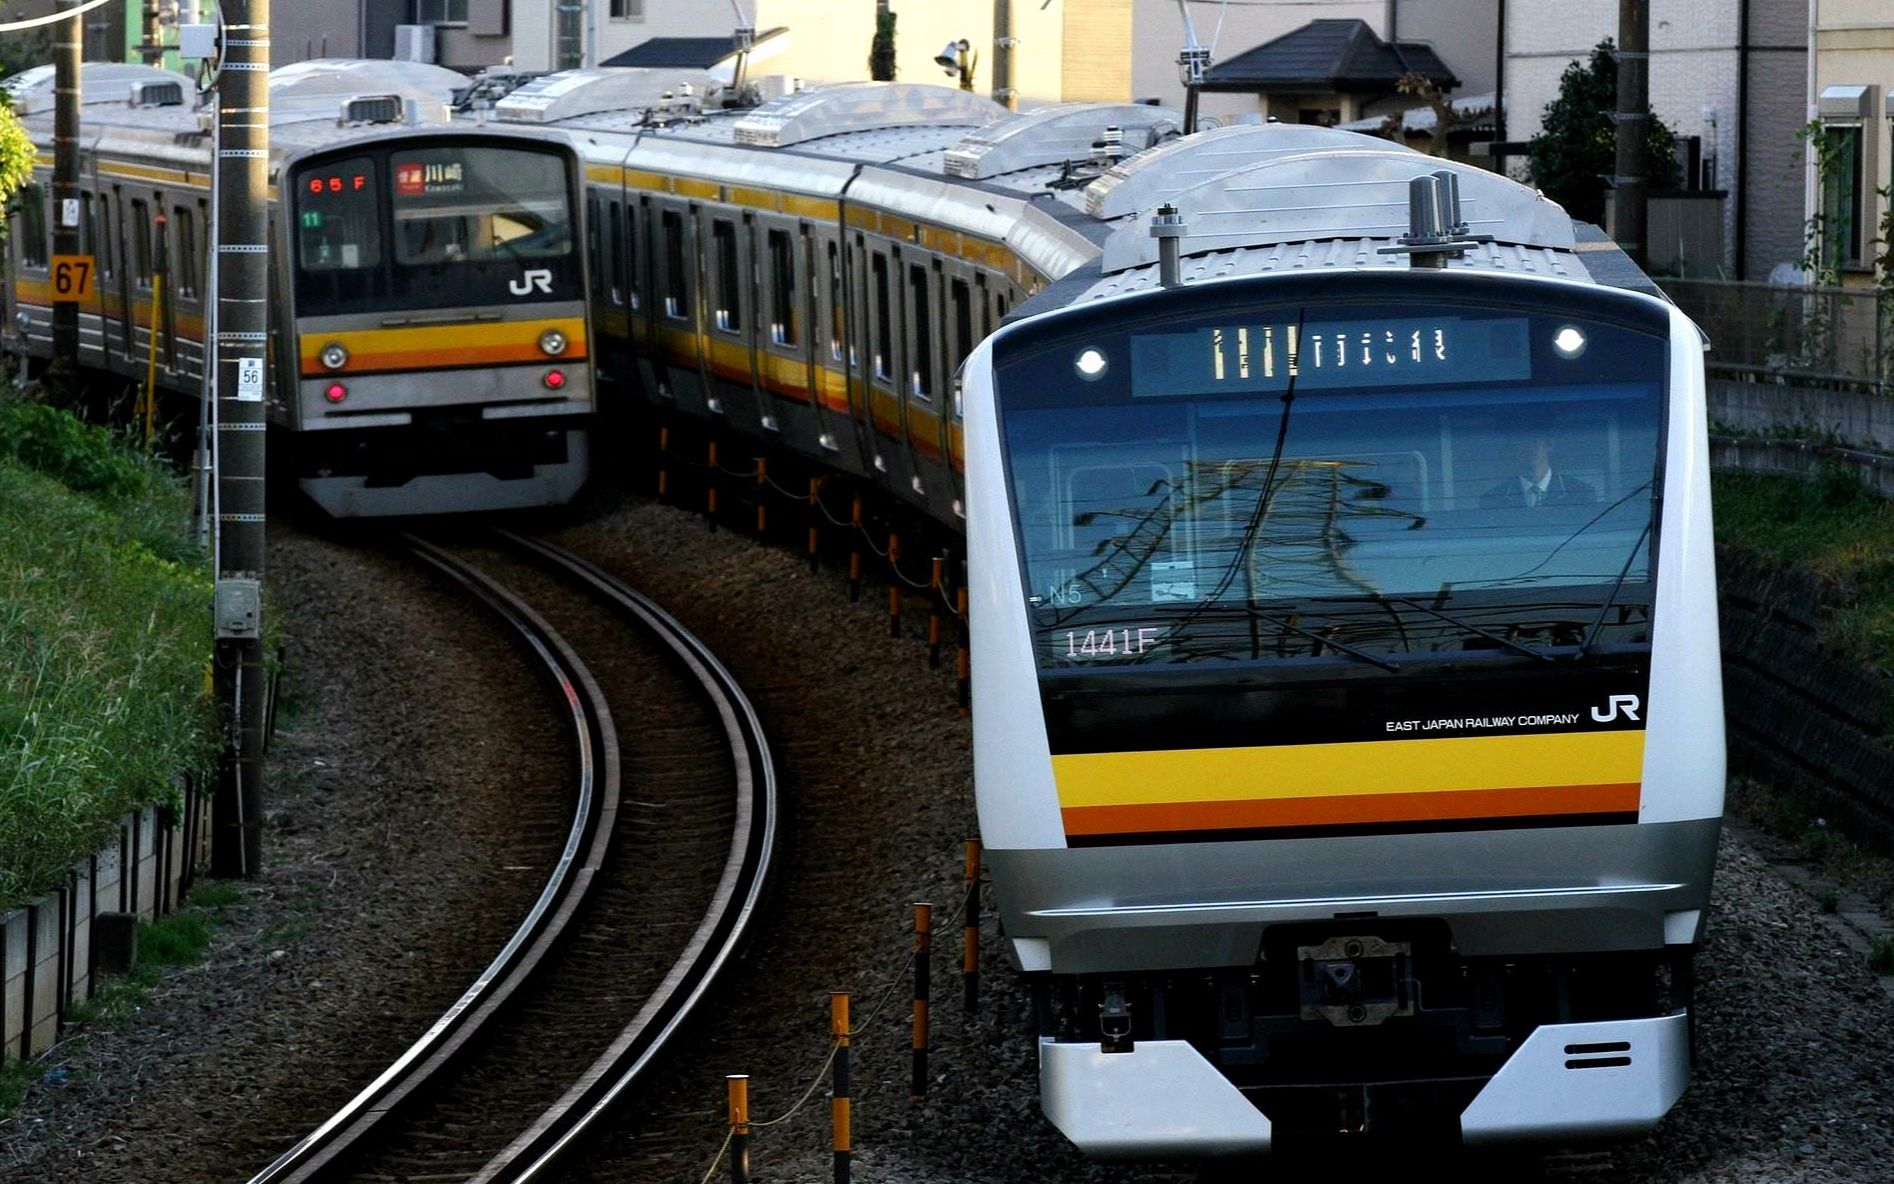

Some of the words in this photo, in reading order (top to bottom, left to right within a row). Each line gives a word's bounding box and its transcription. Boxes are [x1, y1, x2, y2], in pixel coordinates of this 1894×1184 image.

[55, 262, 90, 294] 67
[509, 269, 552, 296] JR
[243, 369, 259, 384] 56
[1050, 584, 1082, 604] N5
[1066, 627, 1158, 657] 1441F
[1591, 694, 1640, 722] JR
[1386, 720, 1420, 732] EAST
[1422, 718, 1464, 731] JAPAN
[1465, 715, 1515, 729] RAILWAY
[1518, 713, 1580, 727] COMPANY
